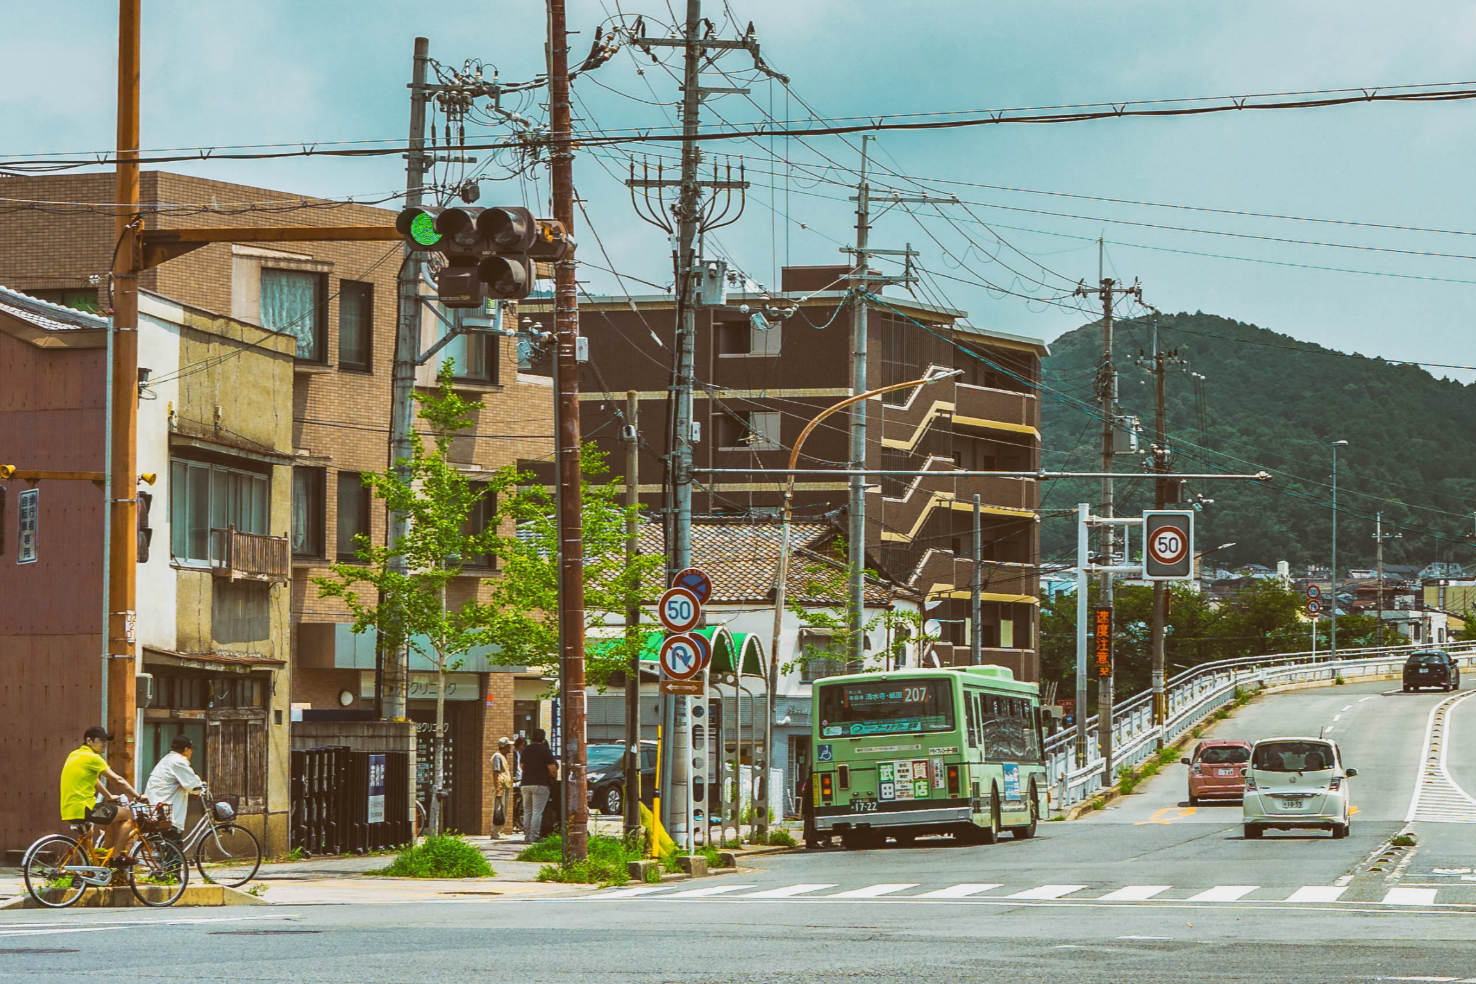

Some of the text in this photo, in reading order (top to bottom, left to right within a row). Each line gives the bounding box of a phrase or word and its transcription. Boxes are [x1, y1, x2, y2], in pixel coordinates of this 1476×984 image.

[1158, 537, 1178, 553] 50
[668, 601, 691, 620] 50
[1096, 610, 1110, 665] 速度注意
[904, 687, 928, 703] 207
[855, 802, 877, 812] 17-22
